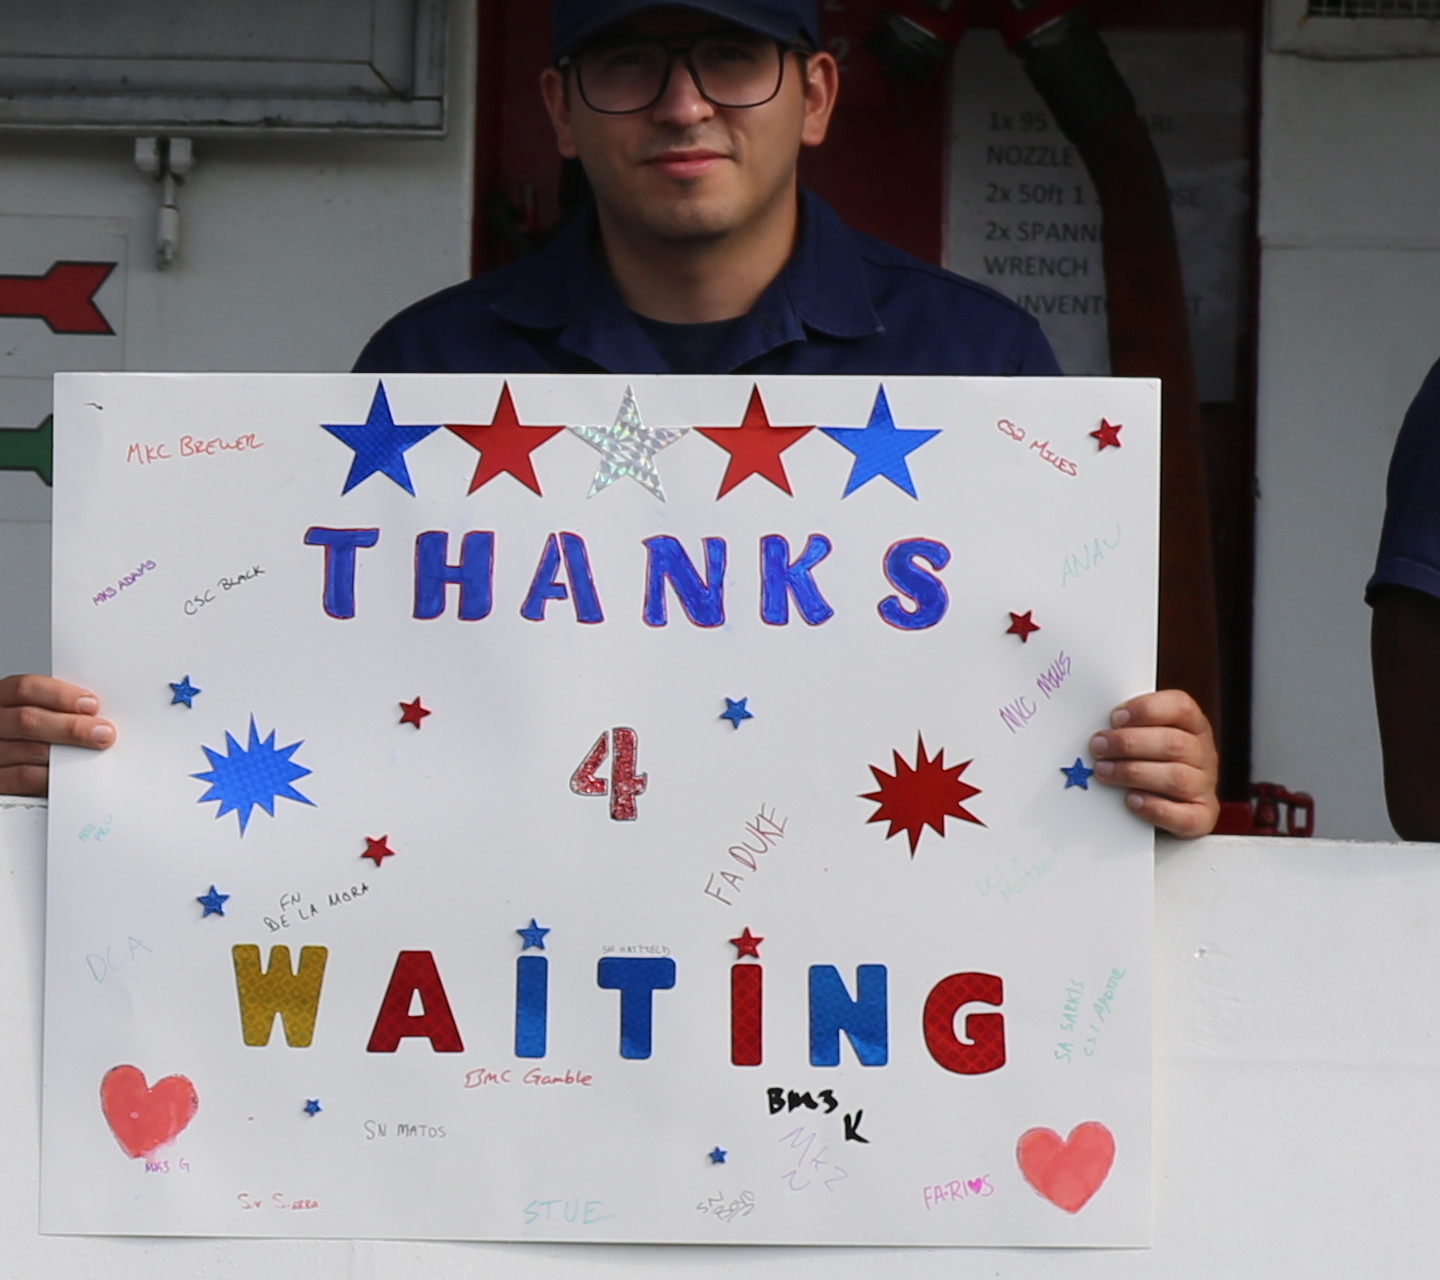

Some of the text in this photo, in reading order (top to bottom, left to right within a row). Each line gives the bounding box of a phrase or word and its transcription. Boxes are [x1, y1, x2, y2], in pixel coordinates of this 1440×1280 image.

[986, 144, 1075, 167] NOZZLE
[985, 182, 1011, 204] 2x
[1019, 182, 1065, 206] 50ft
[984, 221, 1104, 243] 2x SPANN
[983, 255, 1089, 277] WRENCH
[126, 432, 266, 465] MKC BREWER
[91, 559, 157, 607] MK3 ADAMS
[183, 564, 266, 616] CSC BLACK
[303, 526, 954, 634] THANKS
[569, 724, 651, 822] 4
[703, 801, 789, 907] FA DUKE
[262, 881, 371, 933] DE LA MORA
[278, 891, 303, 913] FN
[231, 928, 1009, 1077] WAITING
[522, 1068, 595, 1089] Gamble
[362, 1119, 447, 1142] SN MATOS
[842, 1107, 872, 1145] K
